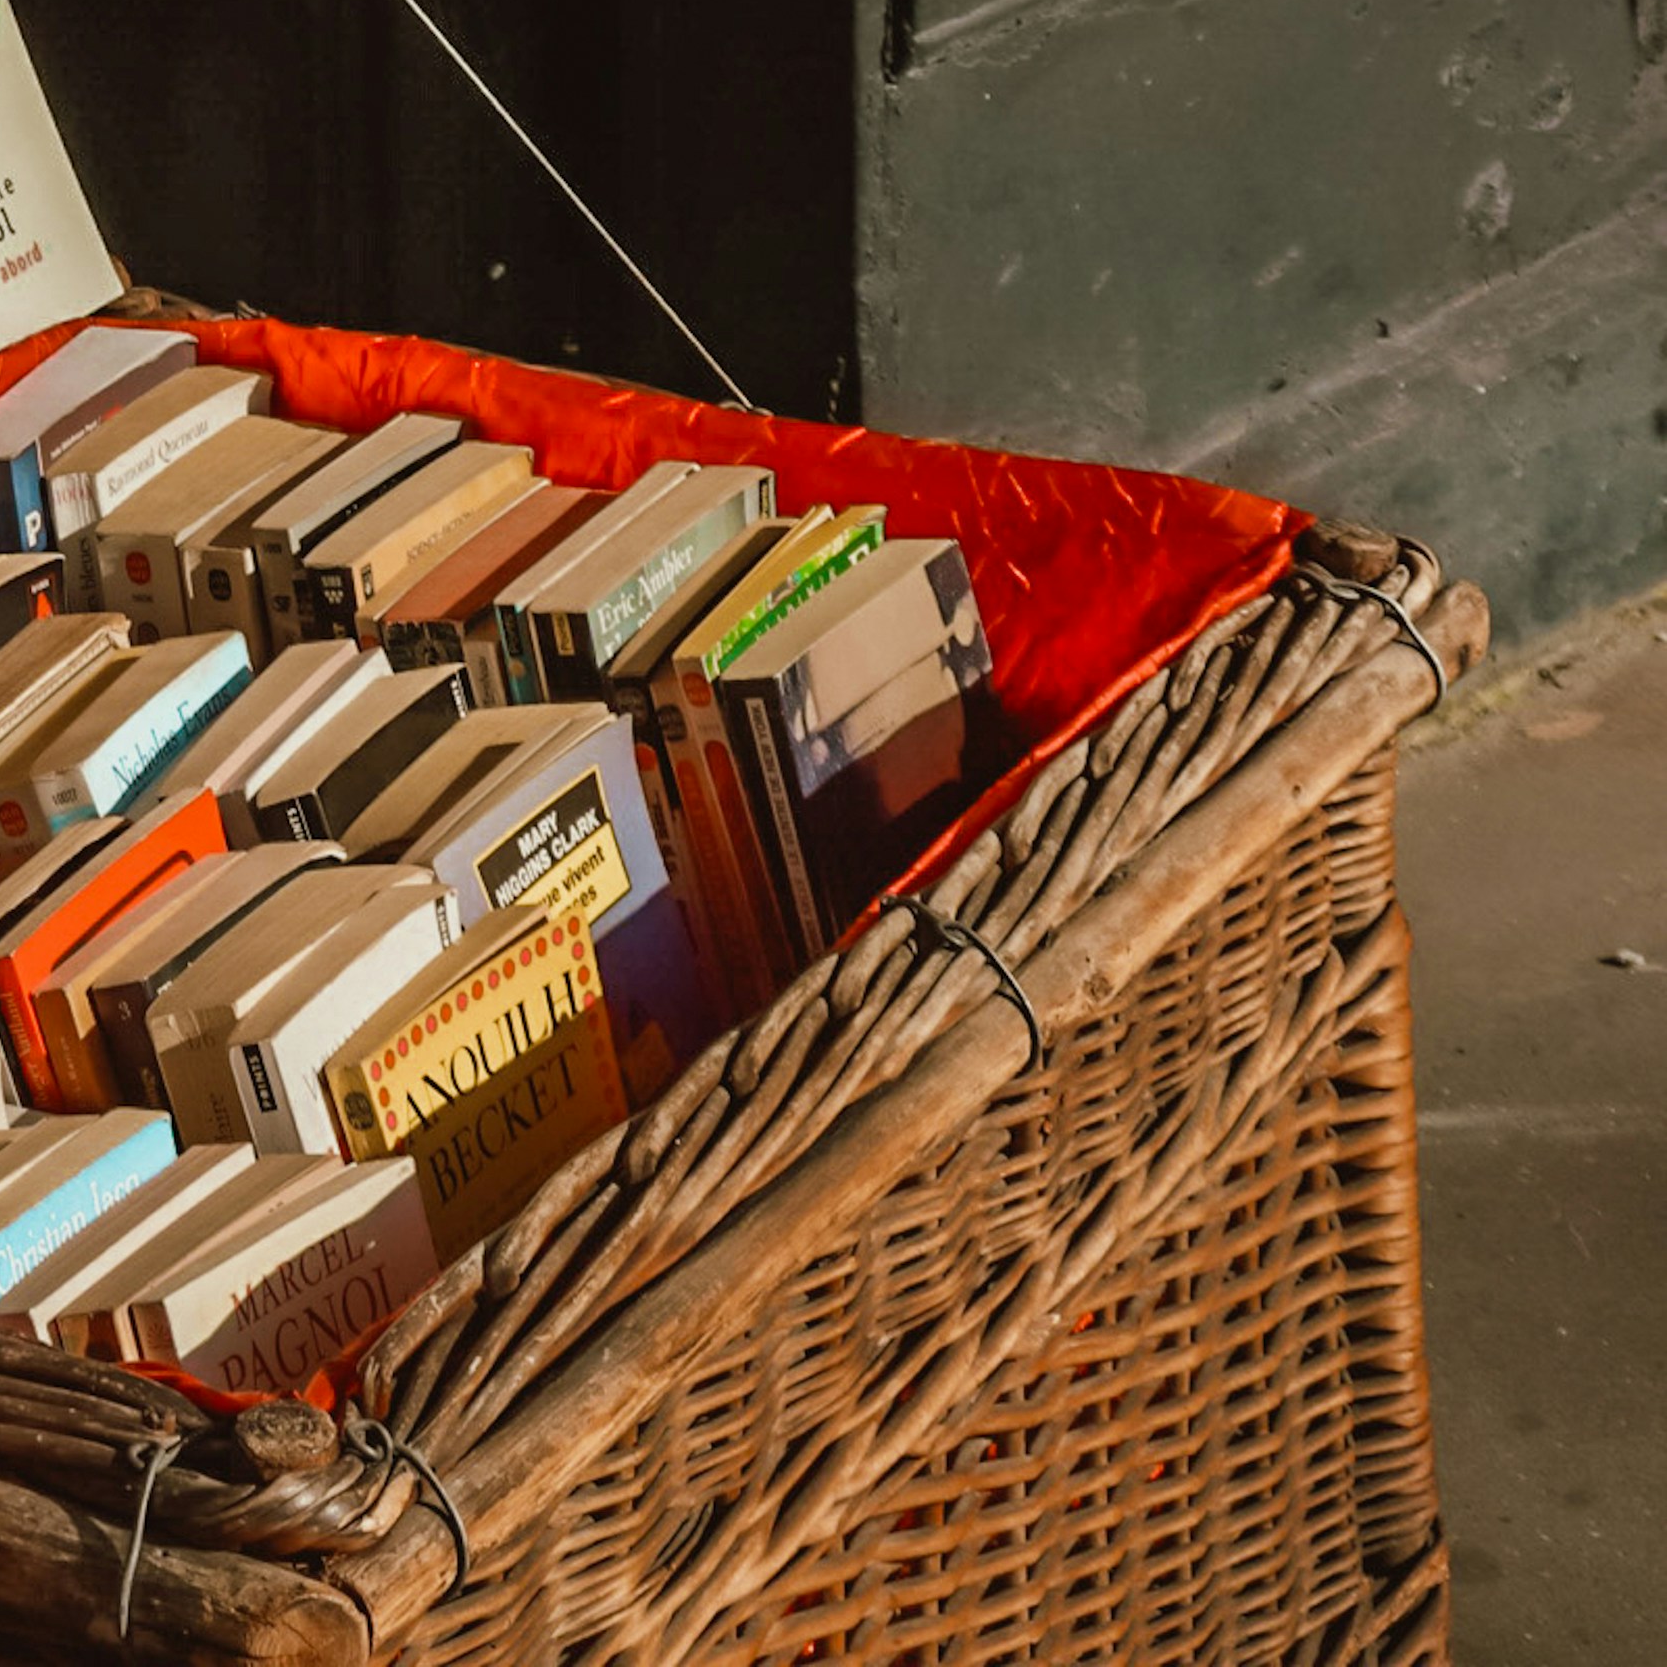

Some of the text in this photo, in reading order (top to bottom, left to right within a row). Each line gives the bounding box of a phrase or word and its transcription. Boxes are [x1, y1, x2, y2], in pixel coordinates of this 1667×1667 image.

[597, 591, 636, 634] Eric
[635, 543, 694, 607] Ambler
[748, 702, 769, 741] YORK
[494, 849, 553, 910] HIGGINS
[551, 807, 602, 861] CLARK
[516, 809, 560, 859] MARY
[561, 844, 607, 893] vivent
[403, 969, 580, 1134] ANOUILH
[428, 1041, 581, 1205] BECKET
[230, 1227, 366, 1333] MARCEL
